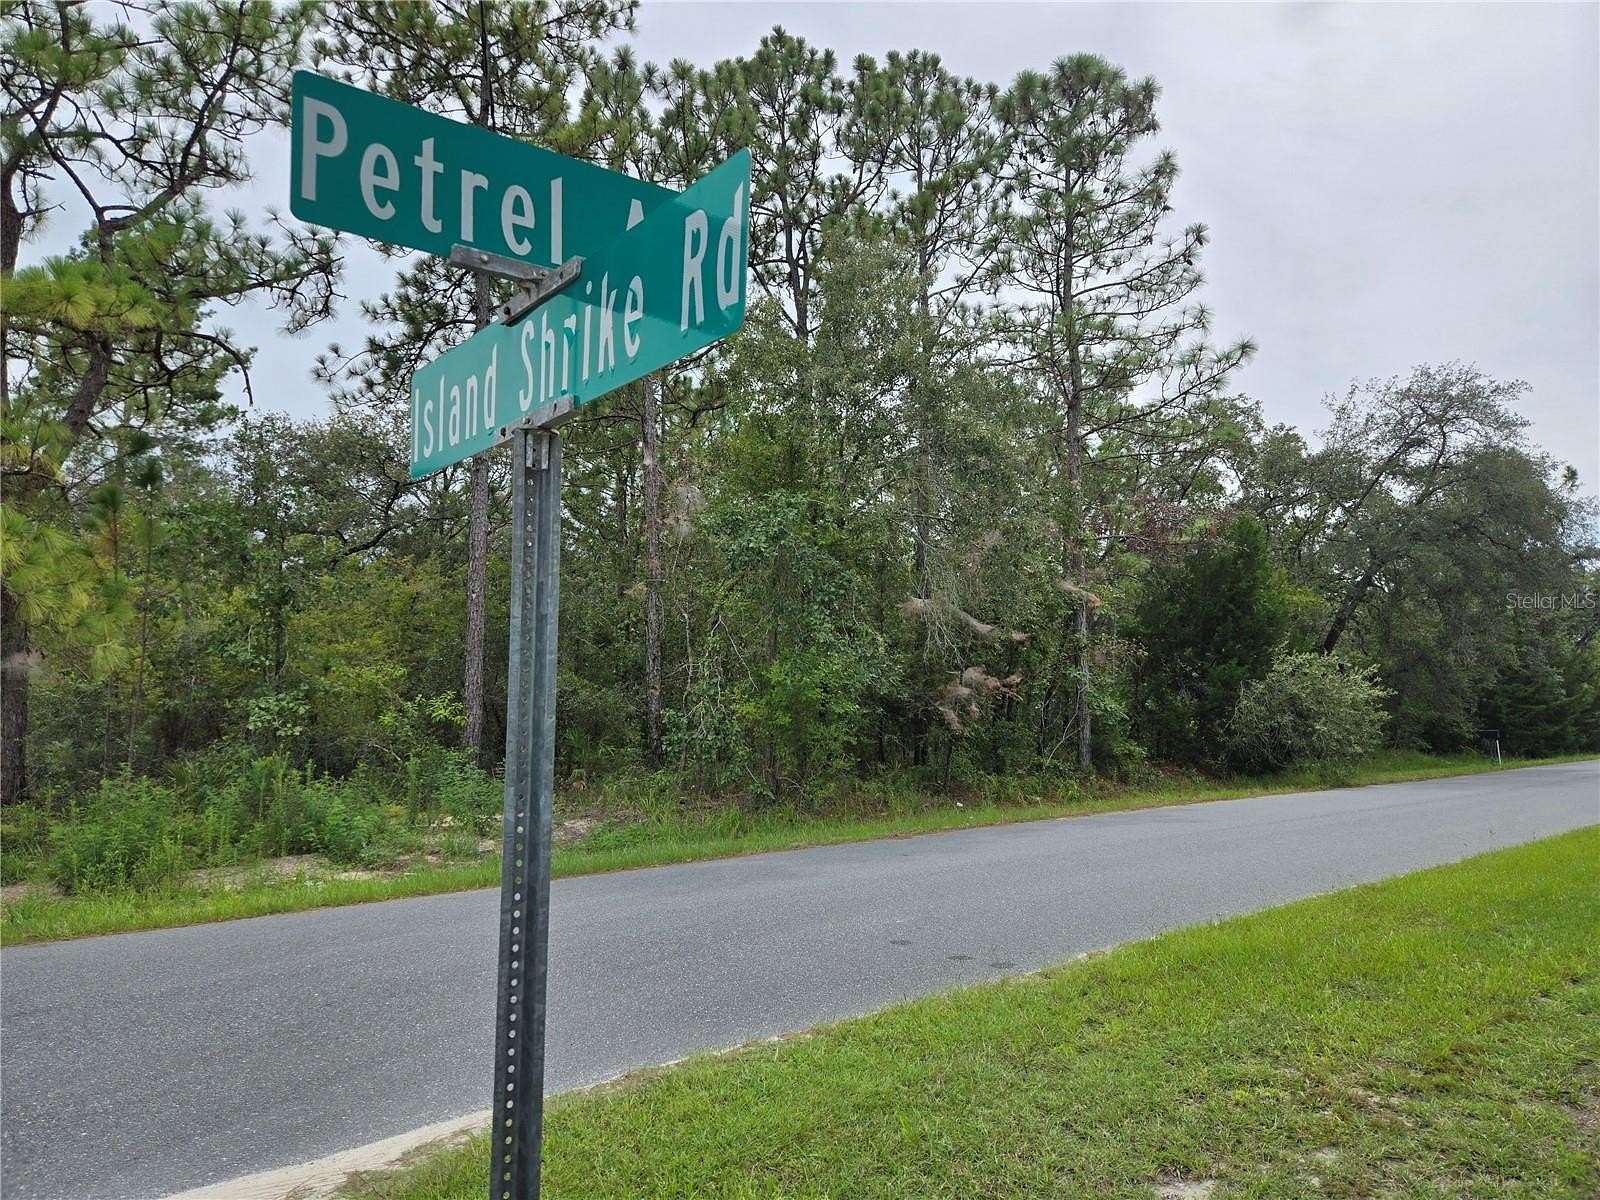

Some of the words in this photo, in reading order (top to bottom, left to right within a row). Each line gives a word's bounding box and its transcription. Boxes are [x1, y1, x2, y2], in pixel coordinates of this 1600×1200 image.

[302, 96, 563, 265] Petrel
[413, 344, 499, 463] Island
[519, 273, 644, 413] Shrike
[680, 181, 744, 332] Rd
